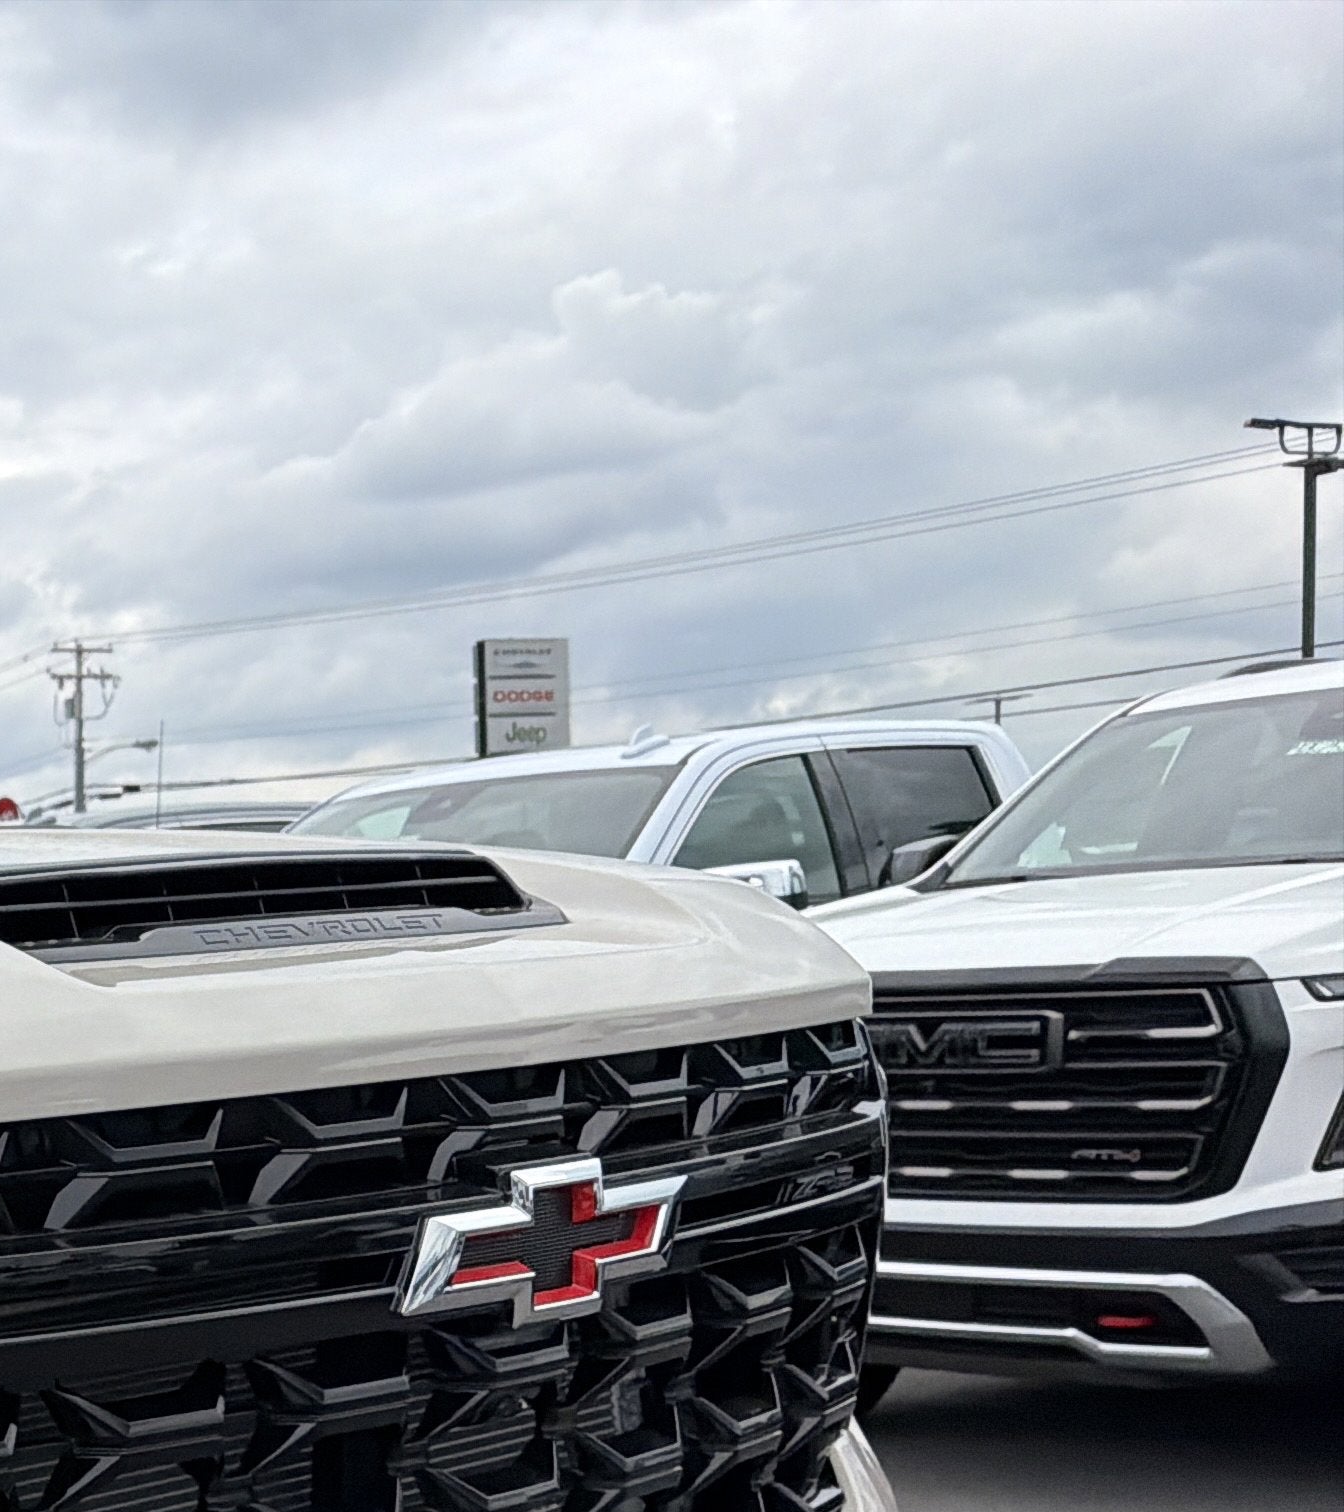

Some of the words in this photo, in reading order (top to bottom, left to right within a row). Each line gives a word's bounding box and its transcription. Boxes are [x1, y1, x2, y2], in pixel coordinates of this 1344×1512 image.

[493, 690, 554, 703] DODGE
[505, 721, 547, 744] Jeep
[194, 913, 443, 945] CHEVROLET
